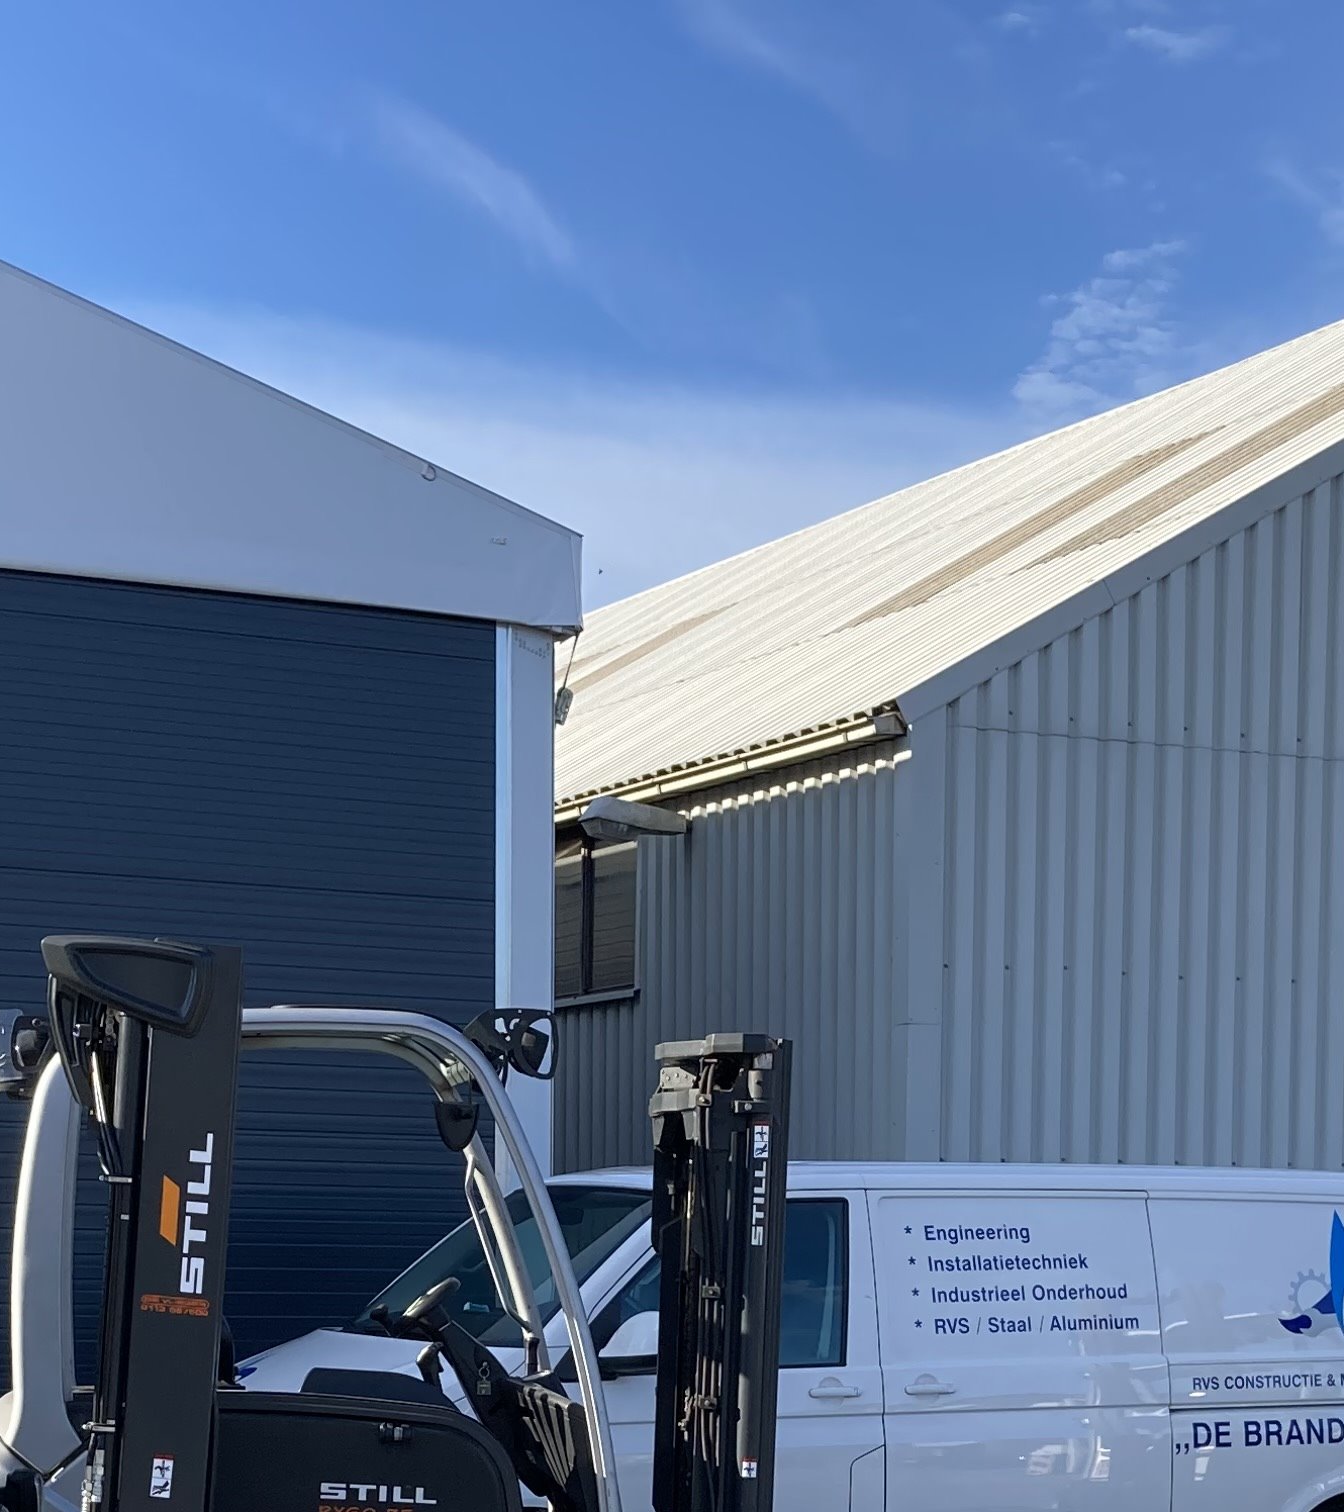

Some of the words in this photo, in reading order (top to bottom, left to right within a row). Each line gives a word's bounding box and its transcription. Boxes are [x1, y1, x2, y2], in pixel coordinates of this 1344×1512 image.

[179, 1132, 214, 1295] STILL
[751, 1160, 767, 1246] STILL
[923, 1223, 1031, 1245] Engineering
[927, 1253, 1089, 1273] Installatietechniek
[931, 1284, 1026, 1304] Industrieel
[1031, 1282, 1129, 1301] Onderhoud
[934, 1317, 970, 1335] RVS
[987, 1316, 1032, 1334] Staal
[1049, 1313, 1140, 1332] Aluminium
[1192, 1375, 1220, 1391] RVS
[1224, 1373, 1323, 1390] CONSTRUCTIE
[1326, 1373, 1336, 1387] &
[319, 1482, 437, 1505] STILL
